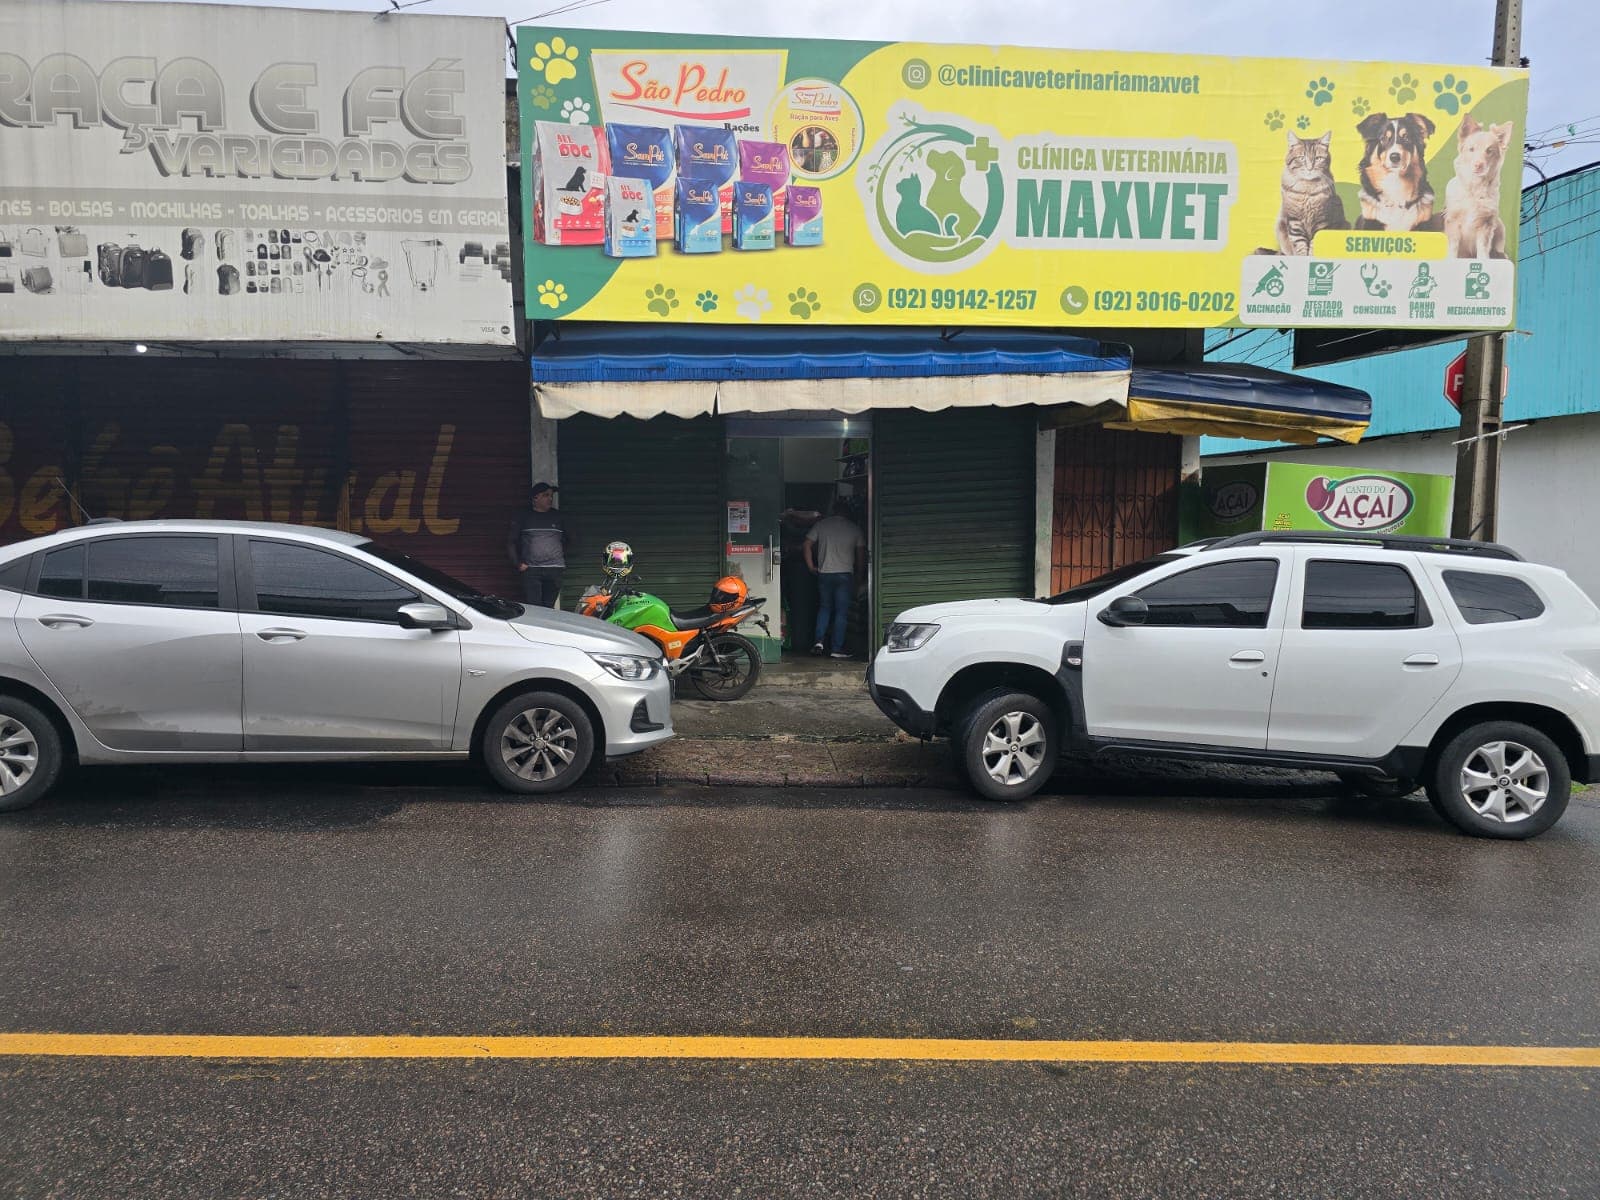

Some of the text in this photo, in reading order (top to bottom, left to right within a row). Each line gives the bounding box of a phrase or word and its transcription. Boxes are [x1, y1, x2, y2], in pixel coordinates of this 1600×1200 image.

[611, 60, 747, 107] São Pedro
[938, 64, 1200, 94] @clinicaveterinariamaxvet
[250, 61, 320, 135] E
[343, 57, 466, 140] FÉ
[722, 122, 760, 134] Rações
[150, 133, 475, 185] VARIEDADES
[559, 143, 592, 158] DOG
[1017, 143, 1228, 174] CLÍNICA VETERINÁRIA
[48, 200, 113, 217] BOLSAS
[131, 202, 222, 219] MOCHILHAS
[240, 204, 310, 222] TOALHAS
[428, 208, 453, 225] EM
[457, 209, 505, 227] GERAL
[1016, 178, 1229, 241] MAXVET
[1345, 236, 1416, 256] SERVIÇOS:
[887, 288, 1038, 311] (92) 99142-1257
[1094, 290, 1235, 312] (92) 3016-0202
[1246, 302, 1292, 315] VACINAÇÃO
[1304, 300, 1343, 310] ATESTADO
[1409, 301, 1436, 310] BANHO
[1302, 309, 1344, 318] DE VIAGEM
[1353, 305, 1397, 315] CONSULTAS
[1415, 310, 1435, 319] TOSA
[1447, 306, 1507, 316] MEDICAMENTOS
[1345, 485, 1386, 493] CANTO DO
[1333, 487, 1396, 525] AÇAÍ
